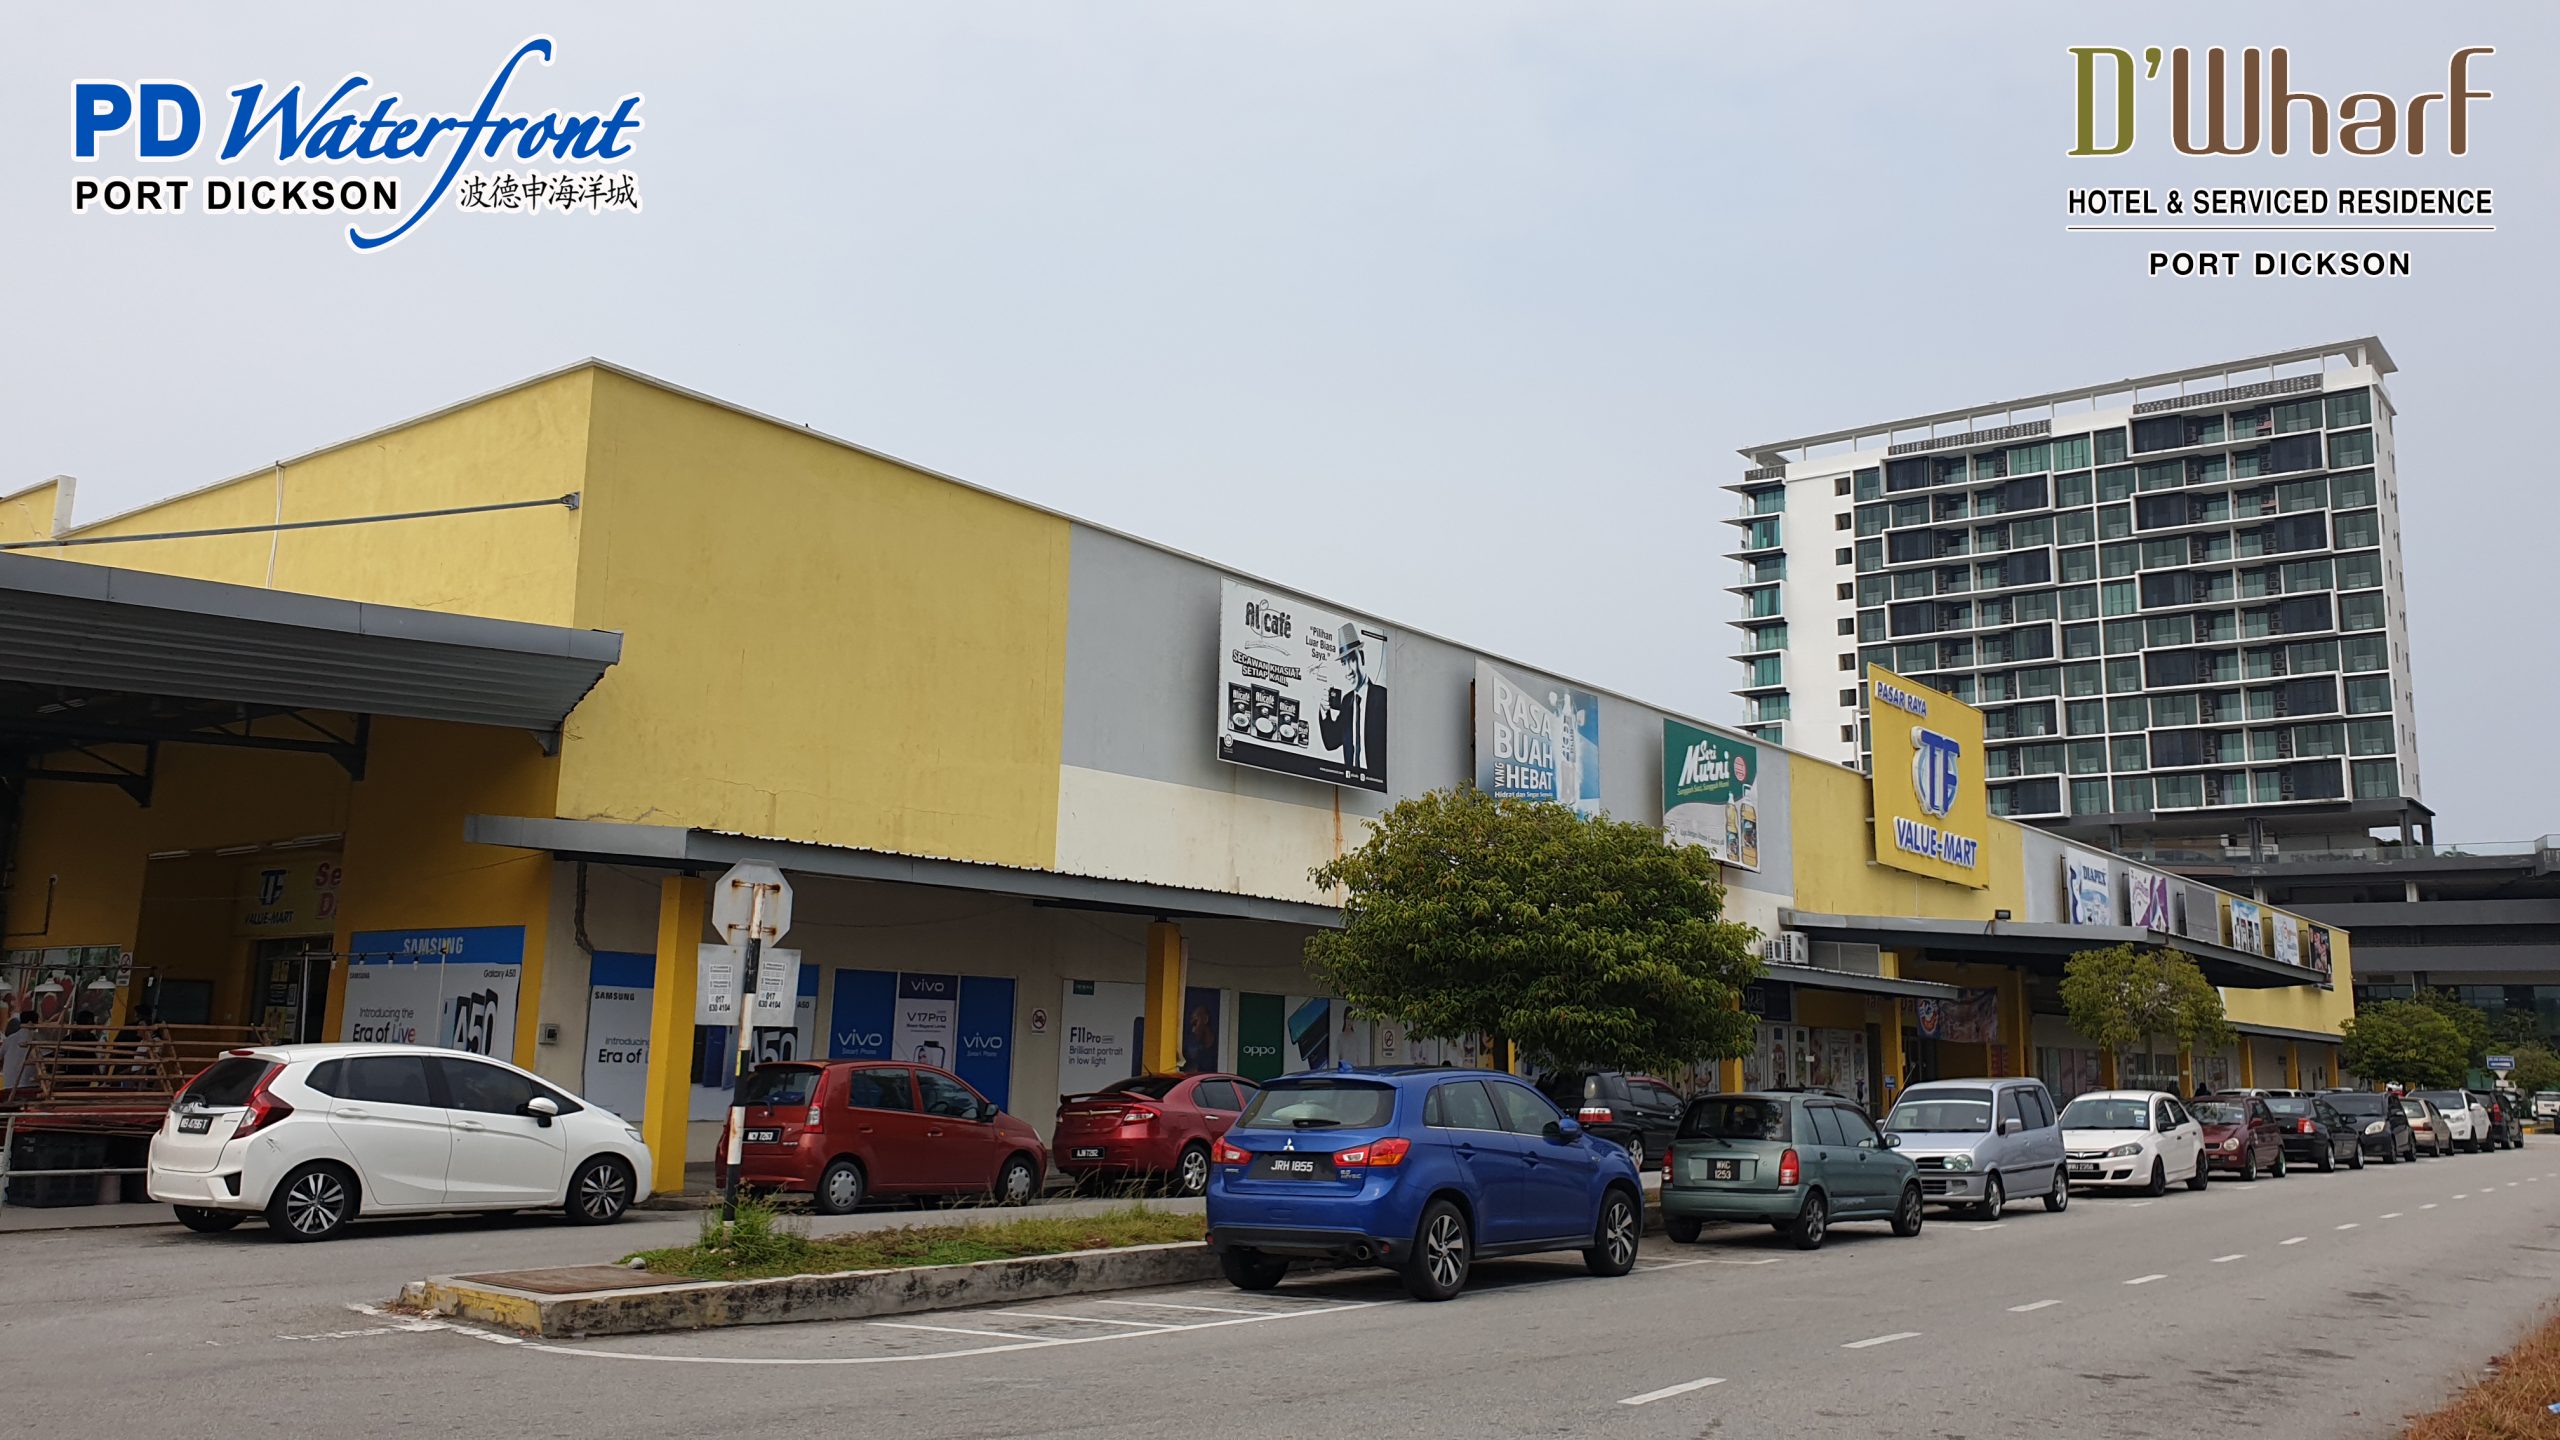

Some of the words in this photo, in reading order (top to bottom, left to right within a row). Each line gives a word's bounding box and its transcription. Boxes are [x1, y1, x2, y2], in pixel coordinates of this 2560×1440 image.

[1305, 635, 1319, 647] Luar
[1320, 640, 1336, 653] Biasa
[1232, 650, 1269, 670] SECAWAN
[1242, 665, 1268, 679] SETIAP
[1493, 676, 1552, 740] RASA
[1877, 682, 1905, 708] PASAR
[1907, 695, 1927, 717] RAYA
[1493, 721, 1553, 770] BUAH
[1699, 740, 1717, 761] Seri
[1678, 745, 1730, 787] Murni
[1494, 762, 1505, 788] YANG
[1506, 764, 1553, 790] HEBAT
[1897, 819, 1977, 866] VALUE-MART
[403, 936, 464, 955] SAMSUNG
[483, 969, 504, 980] Galaxy
[505, 969, 516, 977] A50
[911, 978, 944, 992] vivo
[595, 991, 635, 1001] SAMSUNG
[766, 992, 775, 1000] 017
[359, 1007, 400, 1021] Introducing
[401, 1007, 414, 1018] the
[353, 1024, 374, 1043] Era
[376, 1021, 391, 1043] of
[392, 1021, 416, 1044] Live
[453, 993, 498, 1055] A50
[838, 1029, 882, 1046] vivo
[963, 1032, 1002, 1048] vivo
[598, 1049, 623, 1063] Era
[626, 1048, 642, 1063] of
[1069, 1045, 1095, 1055] Brilliant
[1097, 1047, 1123, 1057] portrait
[1068, 1056, 1075, 1064] in
[1077, 1056, 1089, 1064] low
[1091, 1057, 1106, 1067] light
[1271, 1160, 1290, 1171] JRH
[1291, 1161, 1313, 1172] 1855
[1715, 1170, 1731, 1179] 1253
